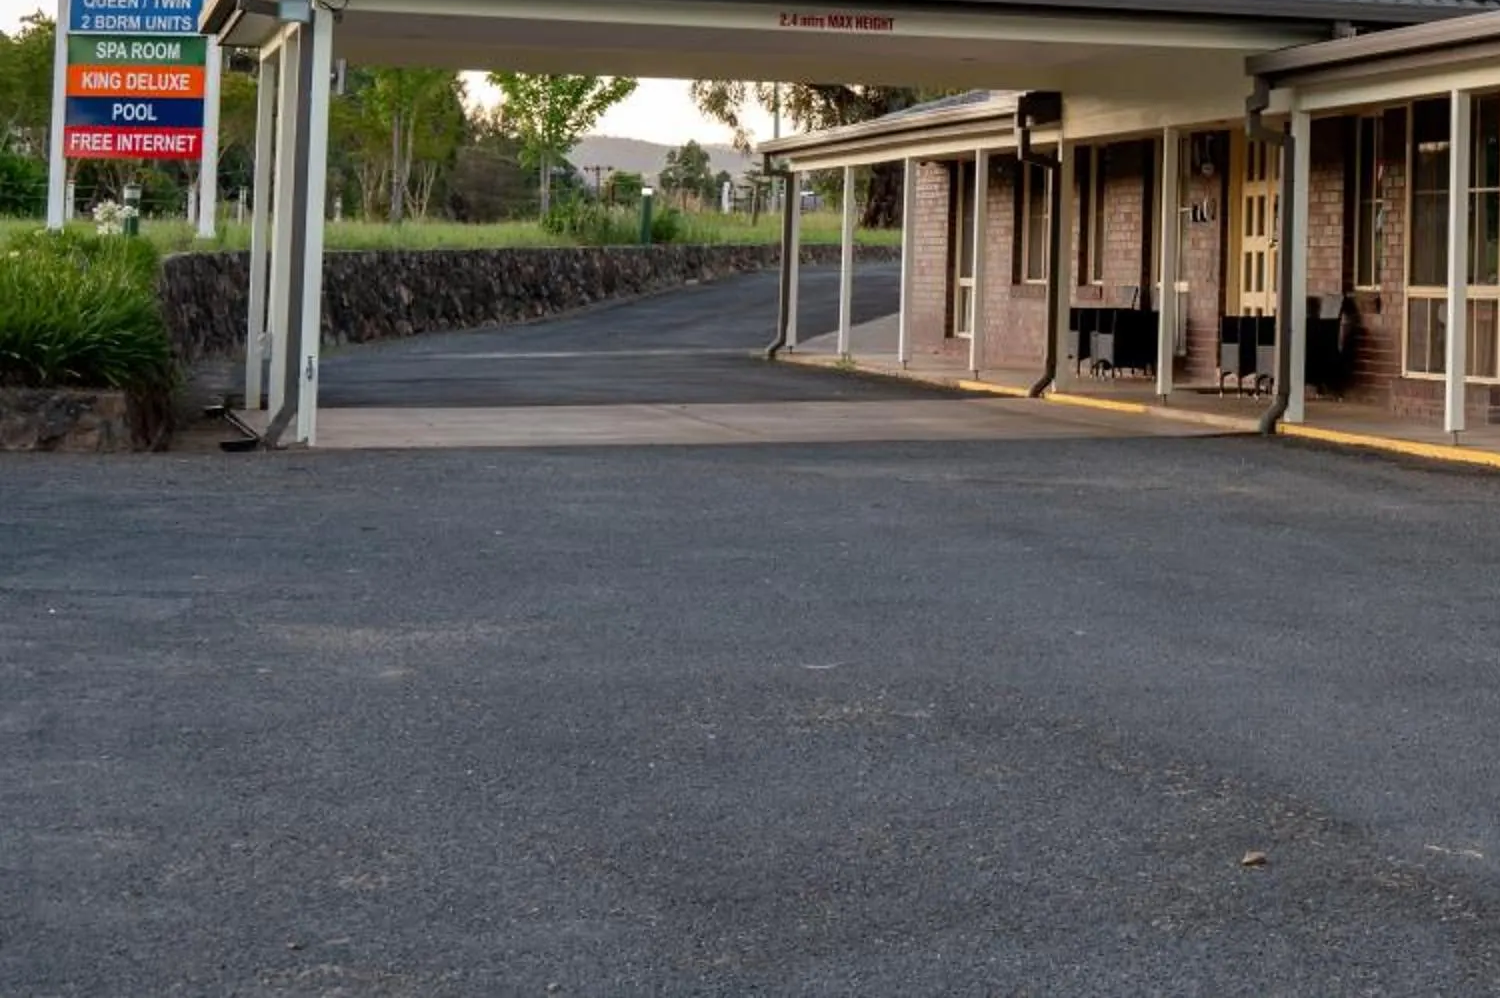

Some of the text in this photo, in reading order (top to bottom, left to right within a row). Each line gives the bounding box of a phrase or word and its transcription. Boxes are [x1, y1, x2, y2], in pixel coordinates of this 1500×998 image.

[80, 14, 193, 31] 2 BDRM UNITS
[827, 14, 853, 30] MAX
[855, 15, 895, 31] HEIGHT
[95, 42, 181, 60] SPA ROOM
[82, 71, 191, 91] KING DELUXE
[111, 103, 158, 121] POOL
[70, 133, 197, 152] FREE INTERNET
